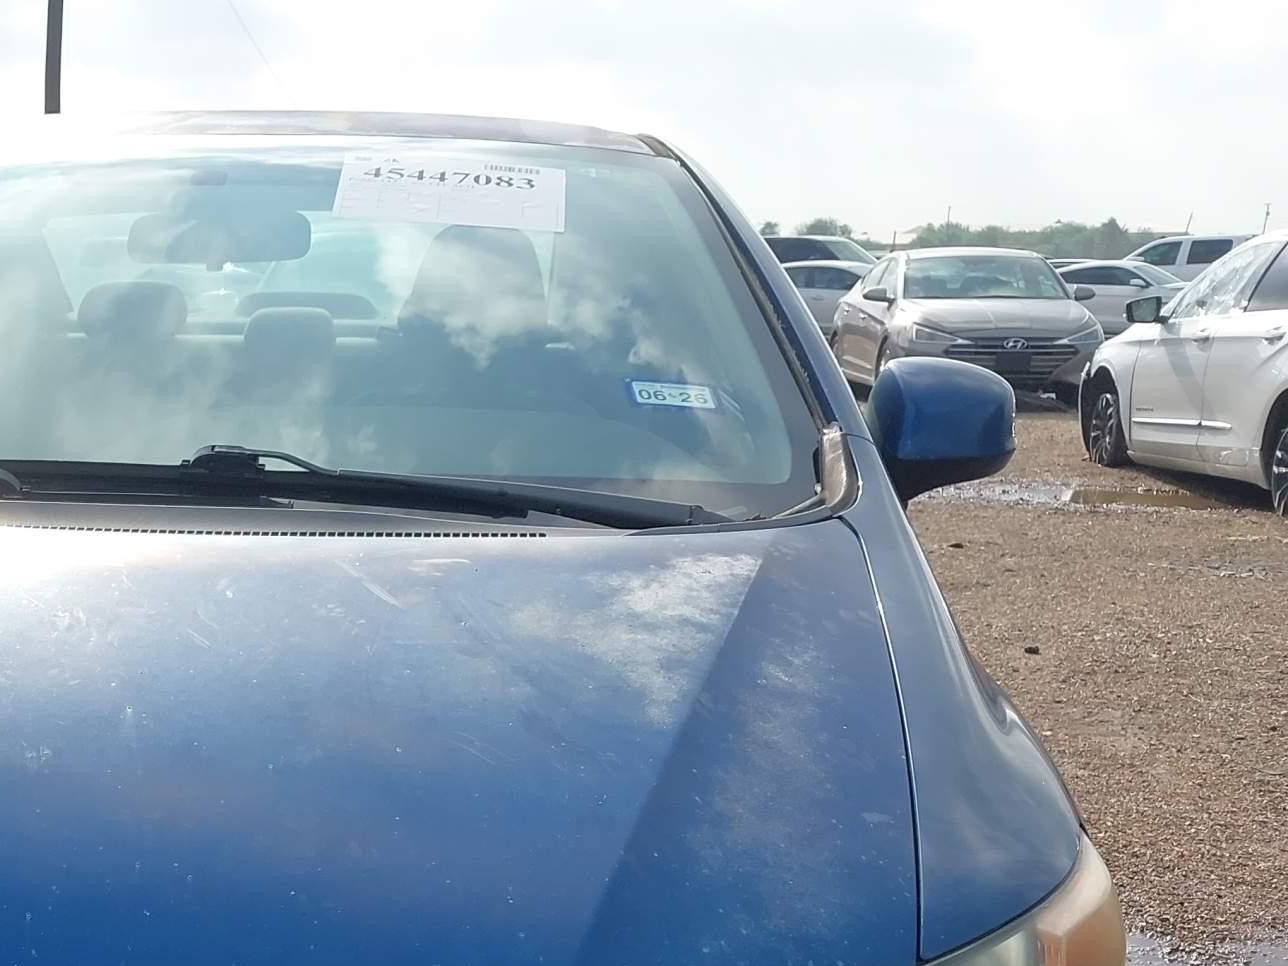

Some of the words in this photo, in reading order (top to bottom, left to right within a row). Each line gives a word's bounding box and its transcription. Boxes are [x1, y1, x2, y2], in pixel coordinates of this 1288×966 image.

[363, 166, 536, 190] 45447083
[638, 388, 667, 402] 06
[678, 391, 709, 405] 26
